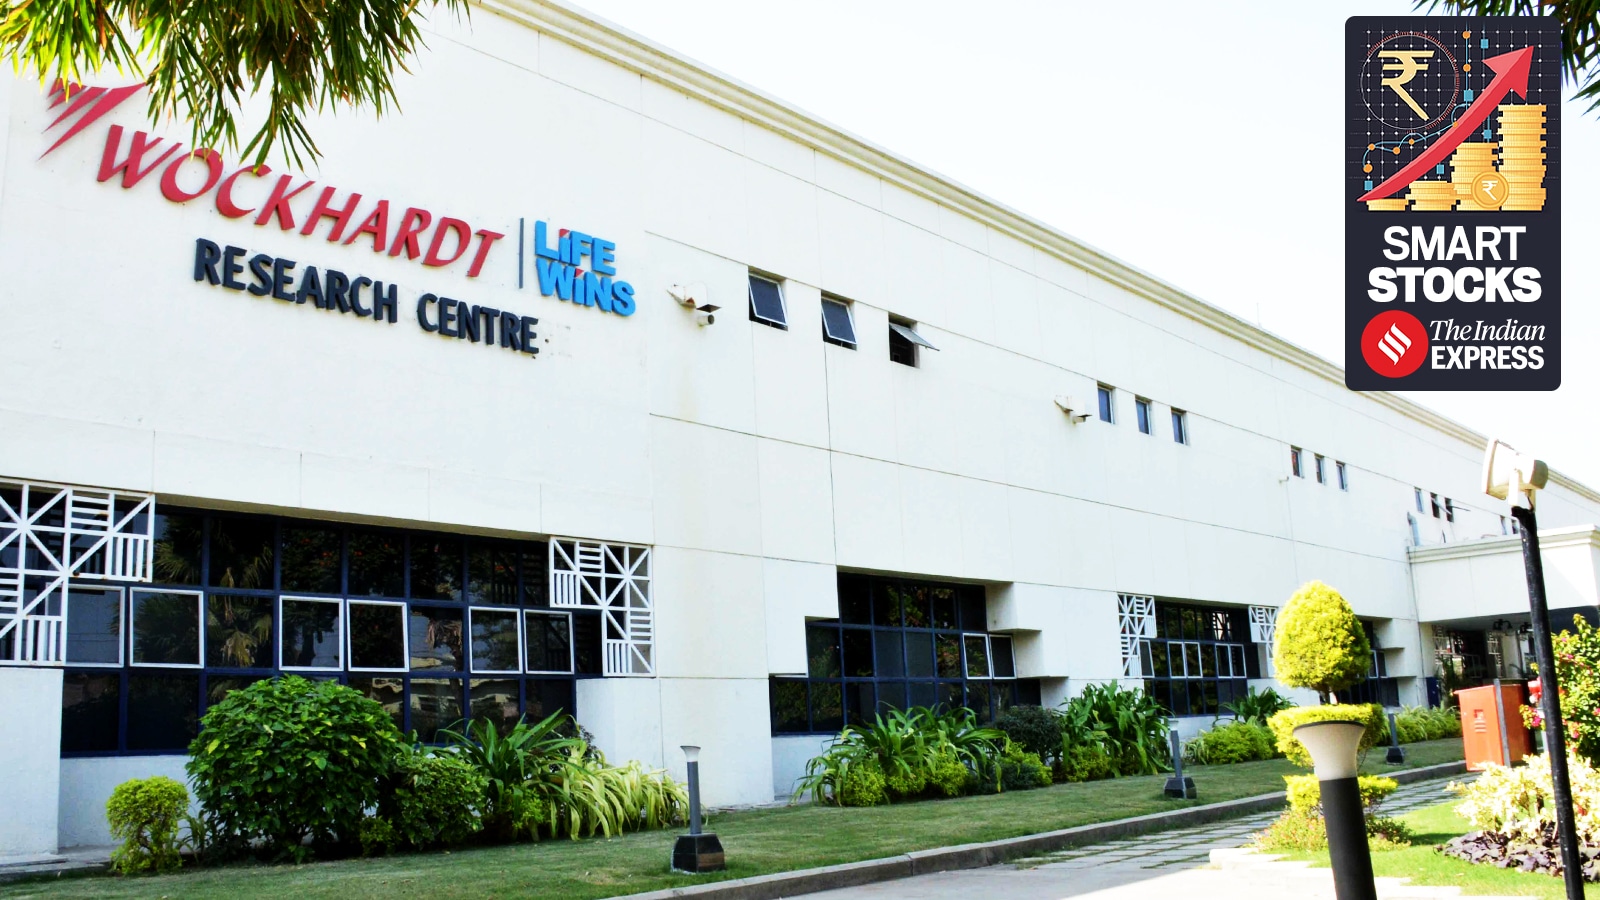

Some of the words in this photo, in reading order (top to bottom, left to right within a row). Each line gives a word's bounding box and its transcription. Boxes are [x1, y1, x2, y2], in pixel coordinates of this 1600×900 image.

[96, 123, 505, 278] WOCKHARDT
[193, 238, 398, 324] RESEARCH
[416, 292, 539, 355] CENTRE
